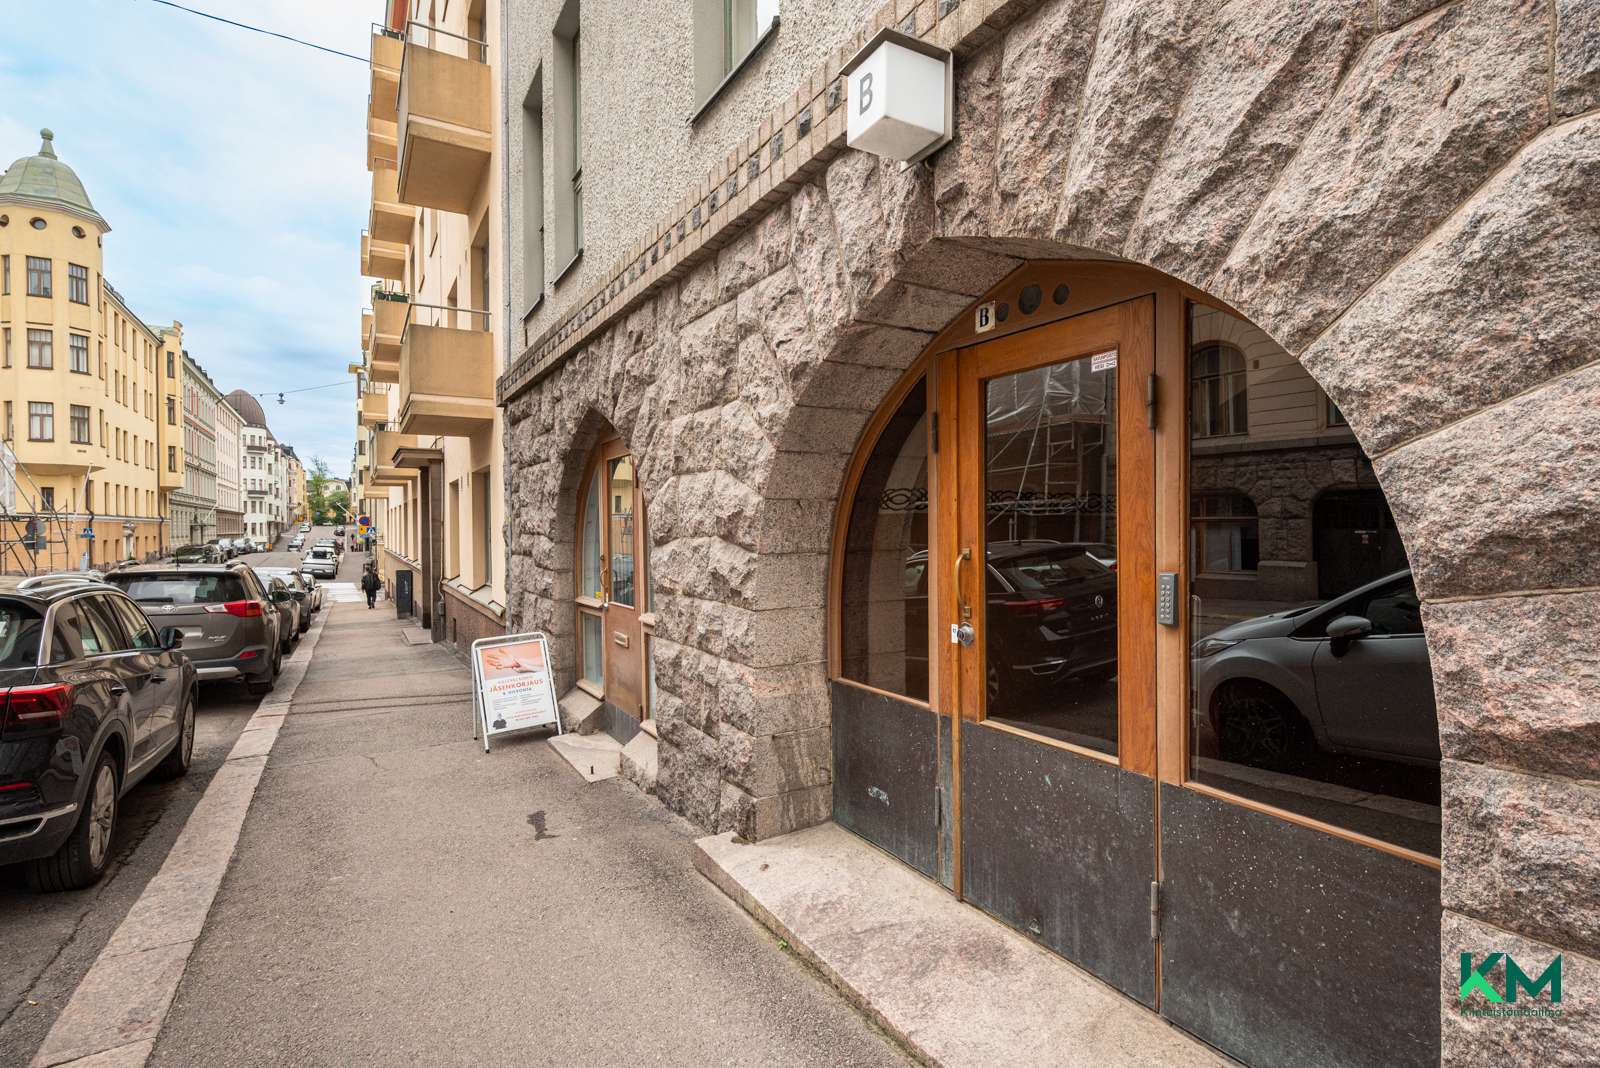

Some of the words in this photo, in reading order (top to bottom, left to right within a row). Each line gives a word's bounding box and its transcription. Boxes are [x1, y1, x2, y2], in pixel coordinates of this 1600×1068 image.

[859, 72, 873, 116] B
[979, 307, 989, 328] B
[489, 678, 544, 693] JÄSENKORJAUS
[498, 675, 534, 684] KALEVALAINEN
